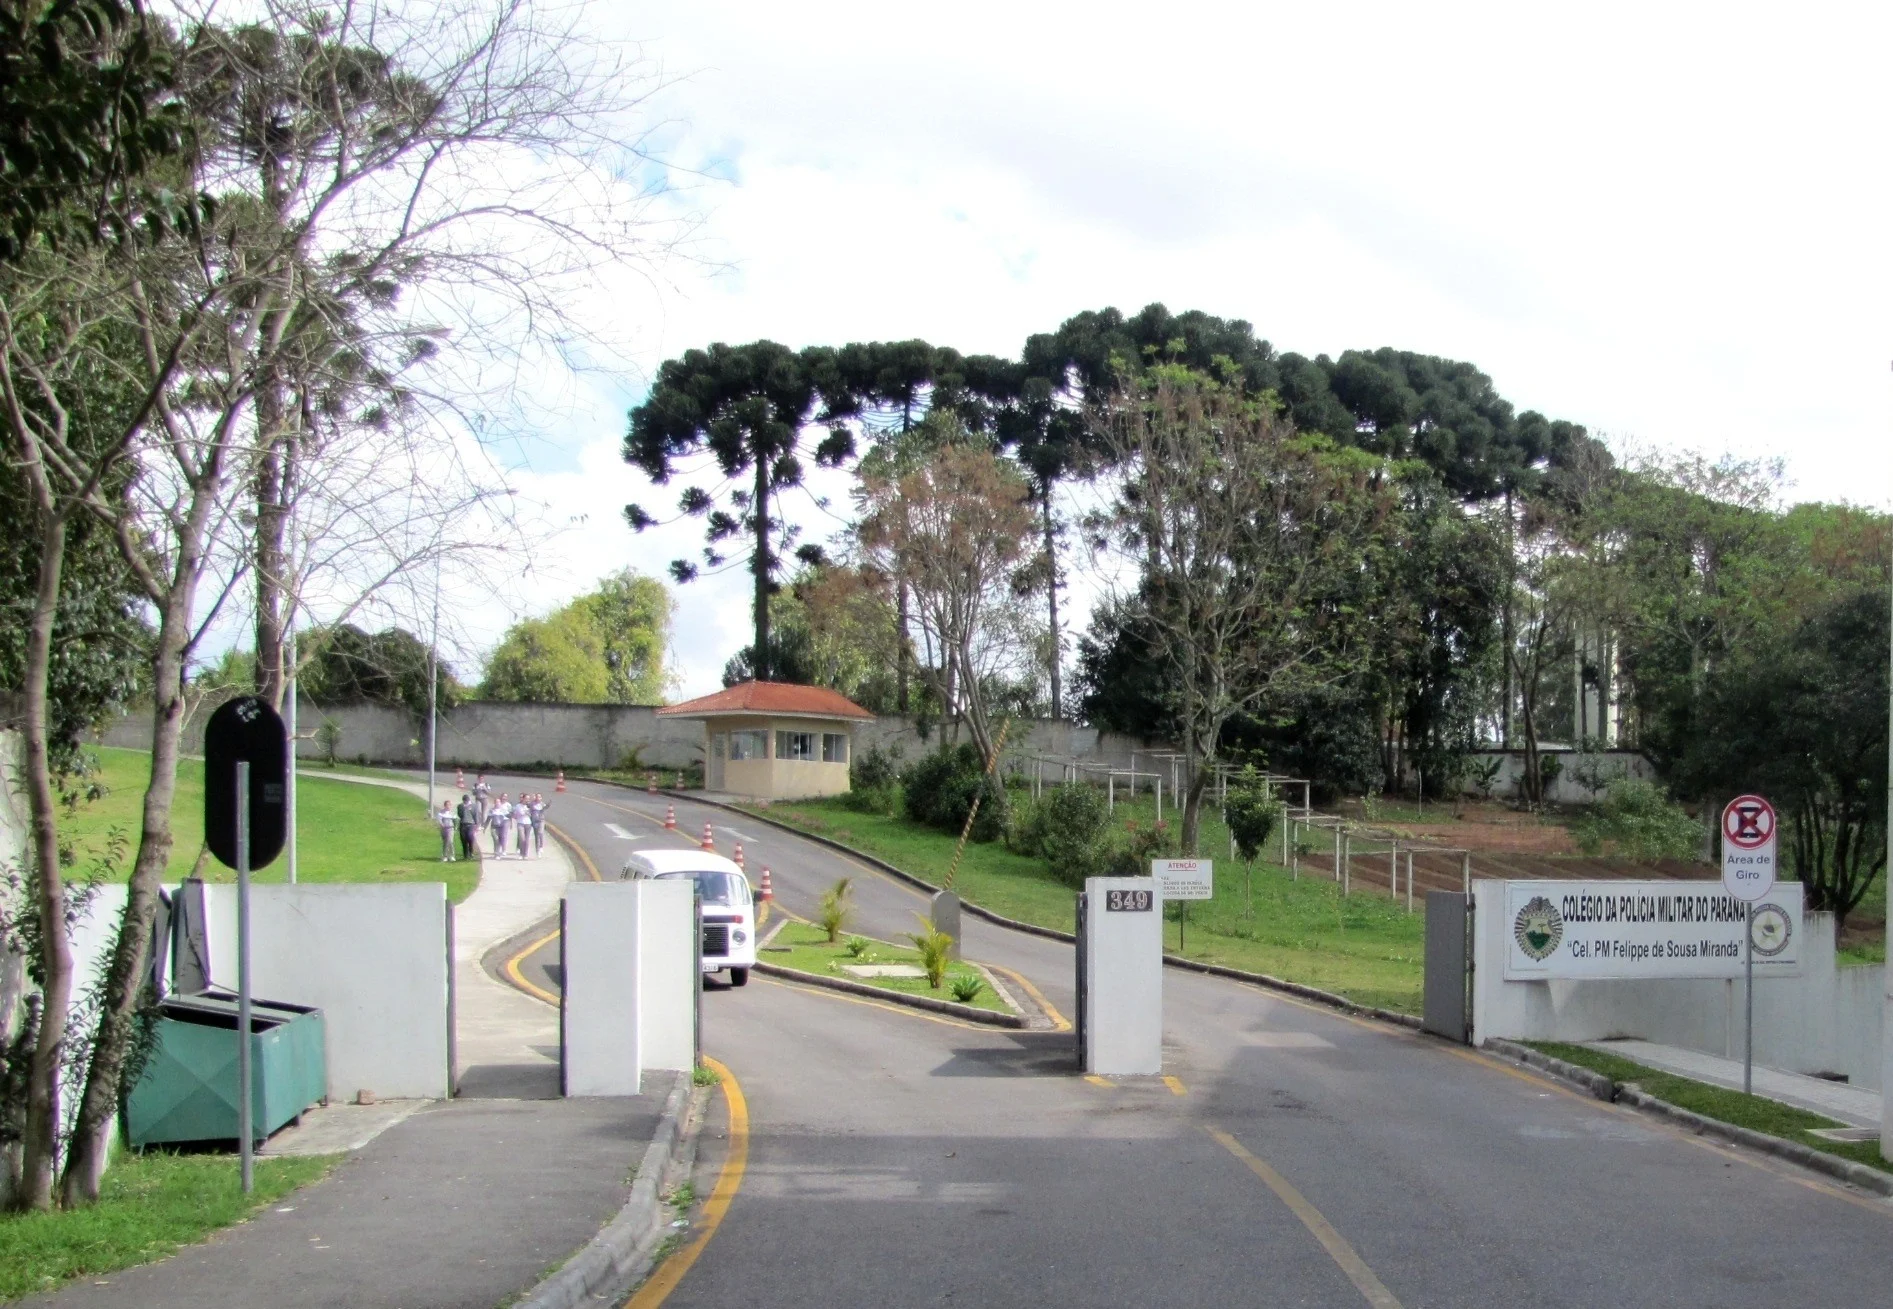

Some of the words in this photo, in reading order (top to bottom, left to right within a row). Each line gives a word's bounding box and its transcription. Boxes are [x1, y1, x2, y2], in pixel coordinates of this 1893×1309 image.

[1168, 861, 1197, 870] ATENÇÃO
[1727, 852, 1753, 864] Área
[1756, 855, 1770, 864] de
[1736, 870, 1760, 879] Giro
[1110, 891, 1148, 910] 349
[1562, 889, 1603, 922] COLÉGIO
[1605, 895, 1617, 922] DA
[1619, 889, 1655, 922] POLÍCIA
[1658, 896, 1693, 922] MILITAR
[1696, 896, 1708, 922] DO
[1594, 940, 1610, 957] PM
[1613, 940, 1649, 962] Felippe
[1652, 940, 1664, 957] de
[1667, 940, 1697, 957] Sousa
